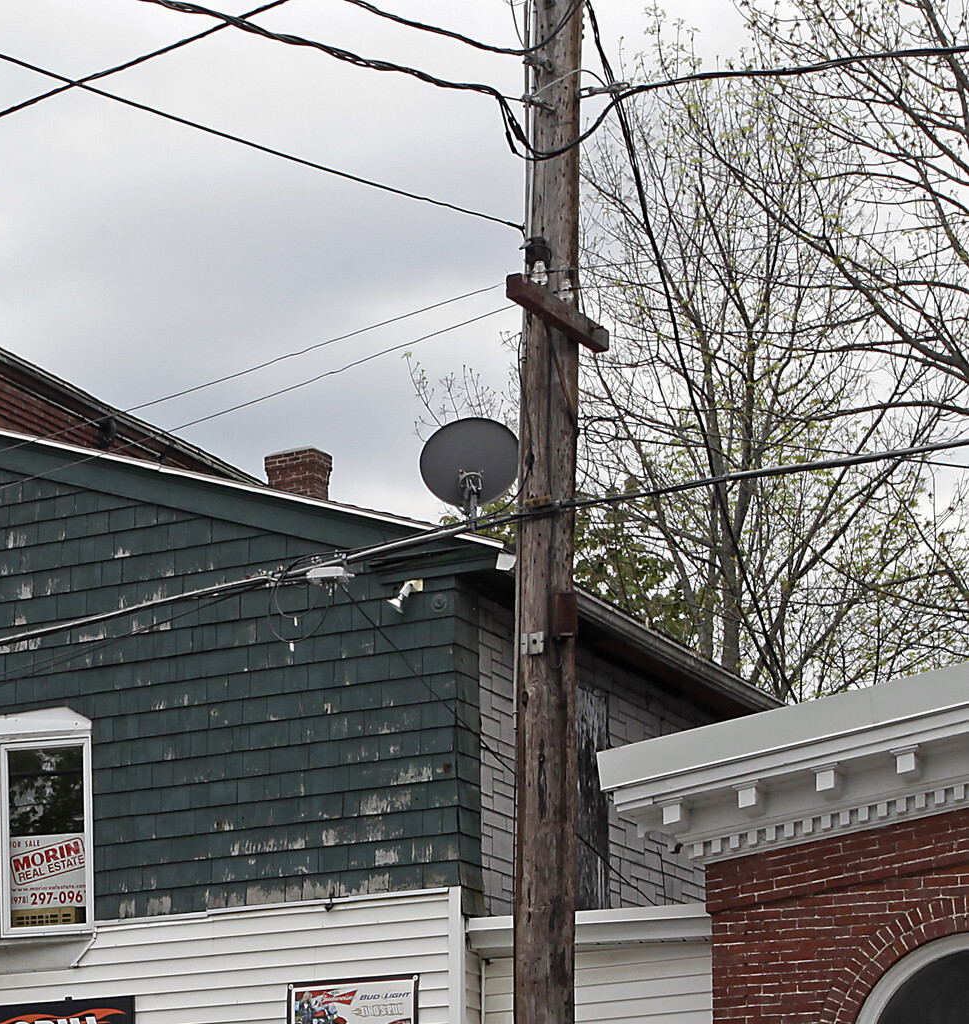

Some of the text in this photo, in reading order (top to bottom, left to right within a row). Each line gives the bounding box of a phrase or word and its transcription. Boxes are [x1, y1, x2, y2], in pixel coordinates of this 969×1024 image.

[25, 840, 40, 848] SALE
[12, 841, 81, 873] MORIN
[18, 854, 85, 882] REAL ESTATE
[384, 992, 412, 1000] LIGHT
